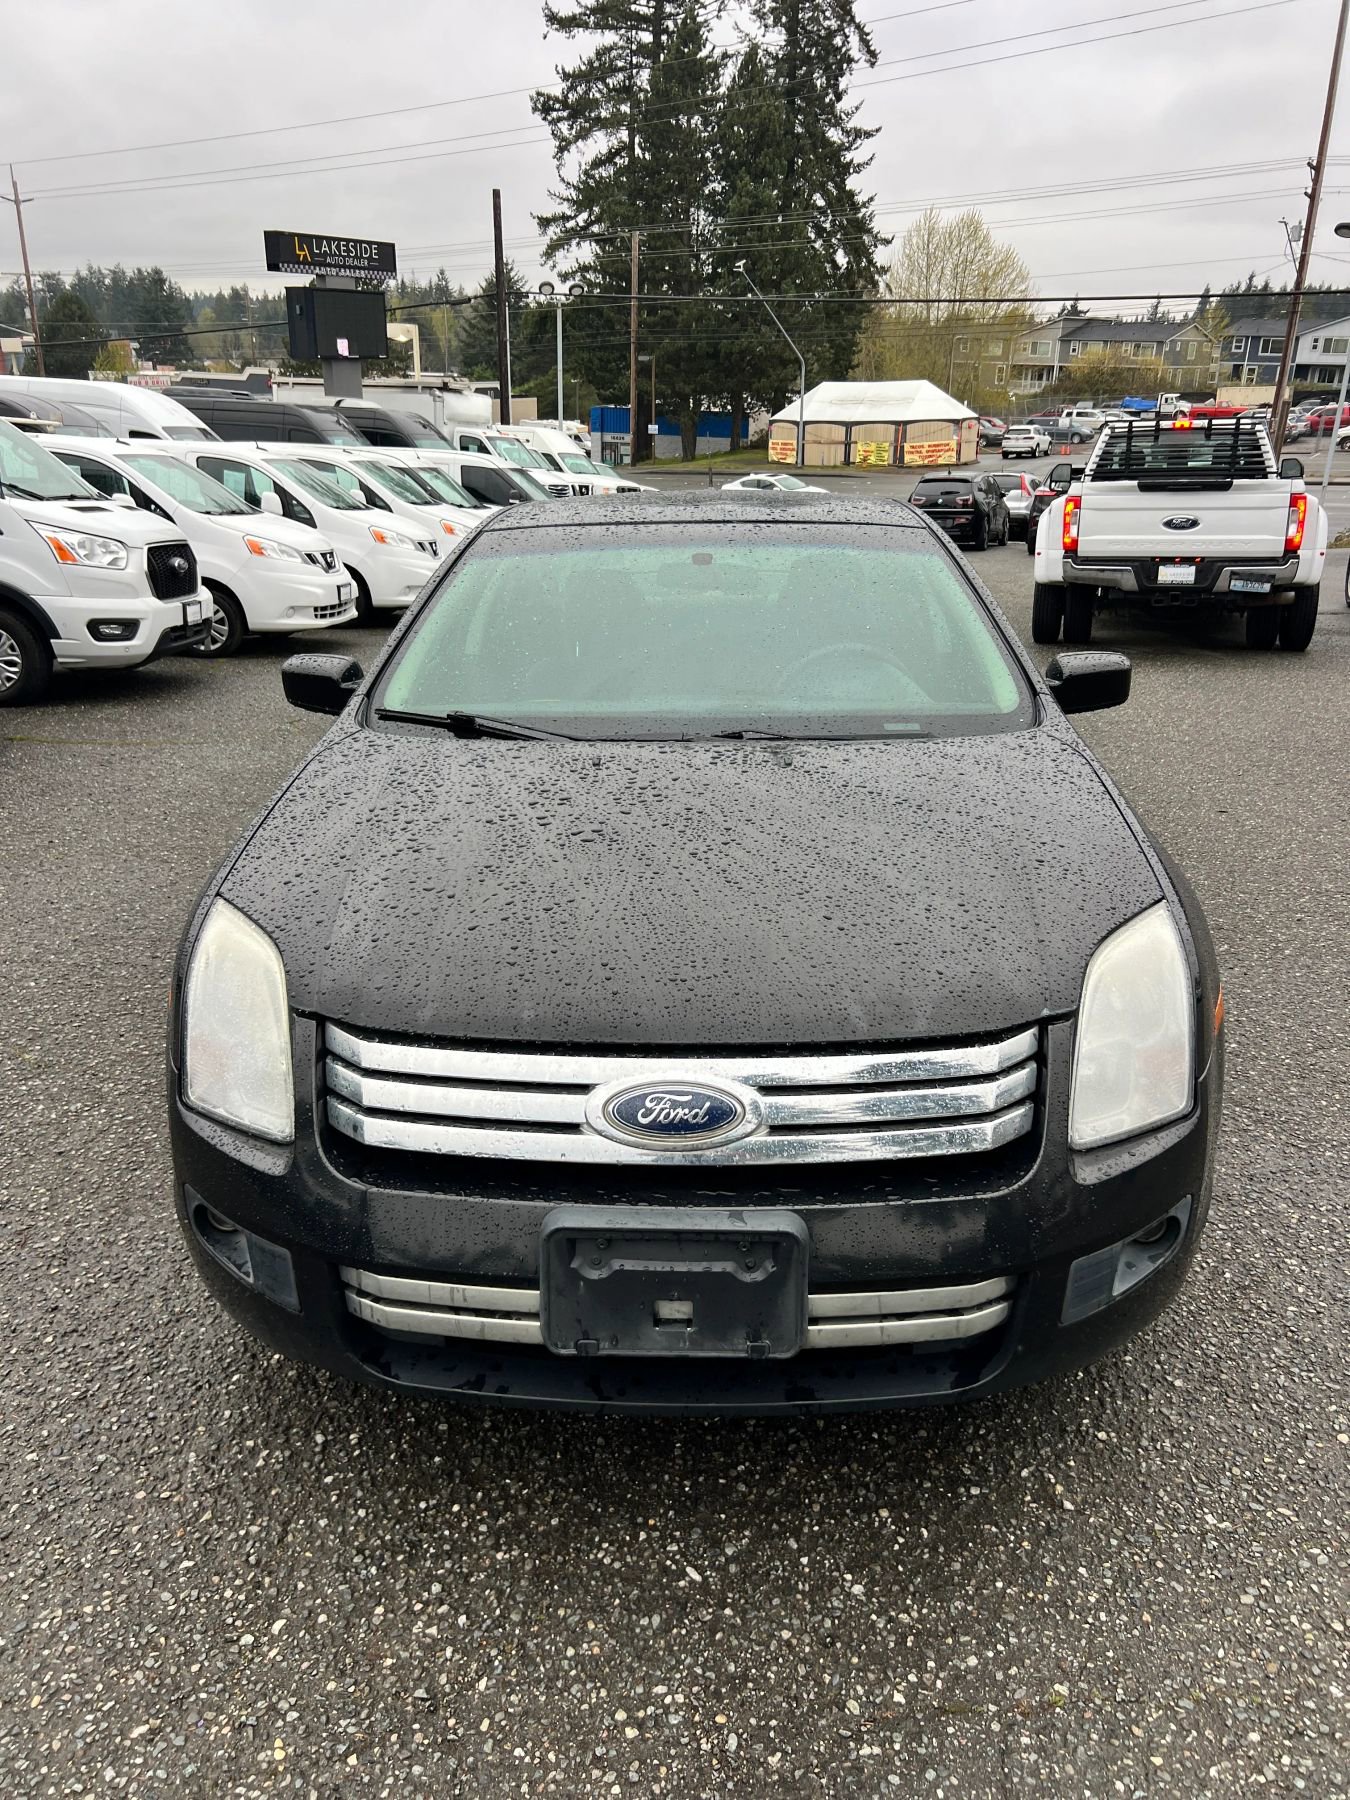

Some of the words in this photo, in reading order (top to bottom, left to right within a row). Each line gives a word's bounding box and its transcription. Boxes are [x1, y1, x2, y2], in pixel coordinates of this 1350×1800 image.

[312, 238, 379, 259] LAKESIDE
[326, 256, 344, 265] AUTO
[345, 257, 369, 267] DEALER
[315, 266, 337, 276] AUTO
[340, 268, 367, 278] SALES
[1170, 518, 1193, 528] Ford
[1107, 541, 1185, 549] SUPER
[1190, 541, 1255, 549] DUTY
[637, 1093, 710, 1125] Ford
